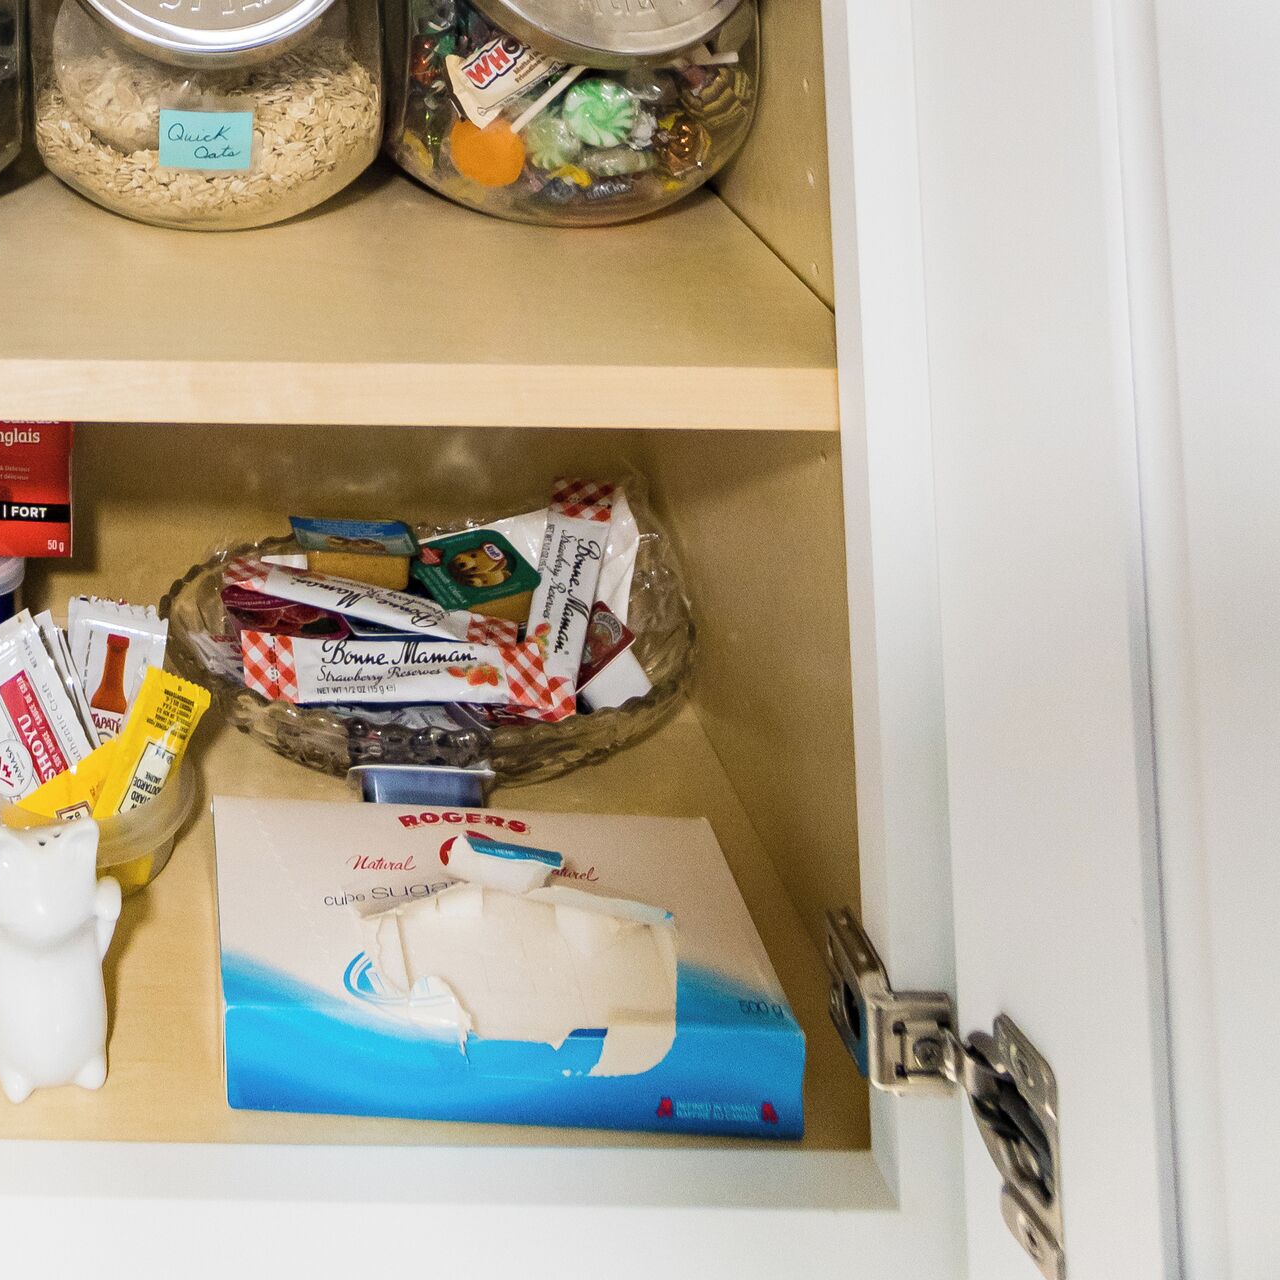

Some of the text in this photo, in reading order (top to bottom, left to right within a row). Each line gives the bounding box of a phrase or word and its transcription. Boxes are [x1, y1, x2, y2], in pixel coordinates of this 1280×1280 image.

[168, 121, 229, 143] Quick
[193, 147, 241, 159] Oats
[11, 506, 47, 518] FORT
[47, 541, 58, 550] 50
[321, 640, 476, 665] Bonne Maman
[317, 665, 383, 684] Strawberry
[17, 714, 57, 782] SHOYU
[6, 747, 24, 785] YAMASA
[398, 812, 529, 833] ROGERS
[347, 855, 417, 872] Natural
[740, 999, 768, 1014] 500
